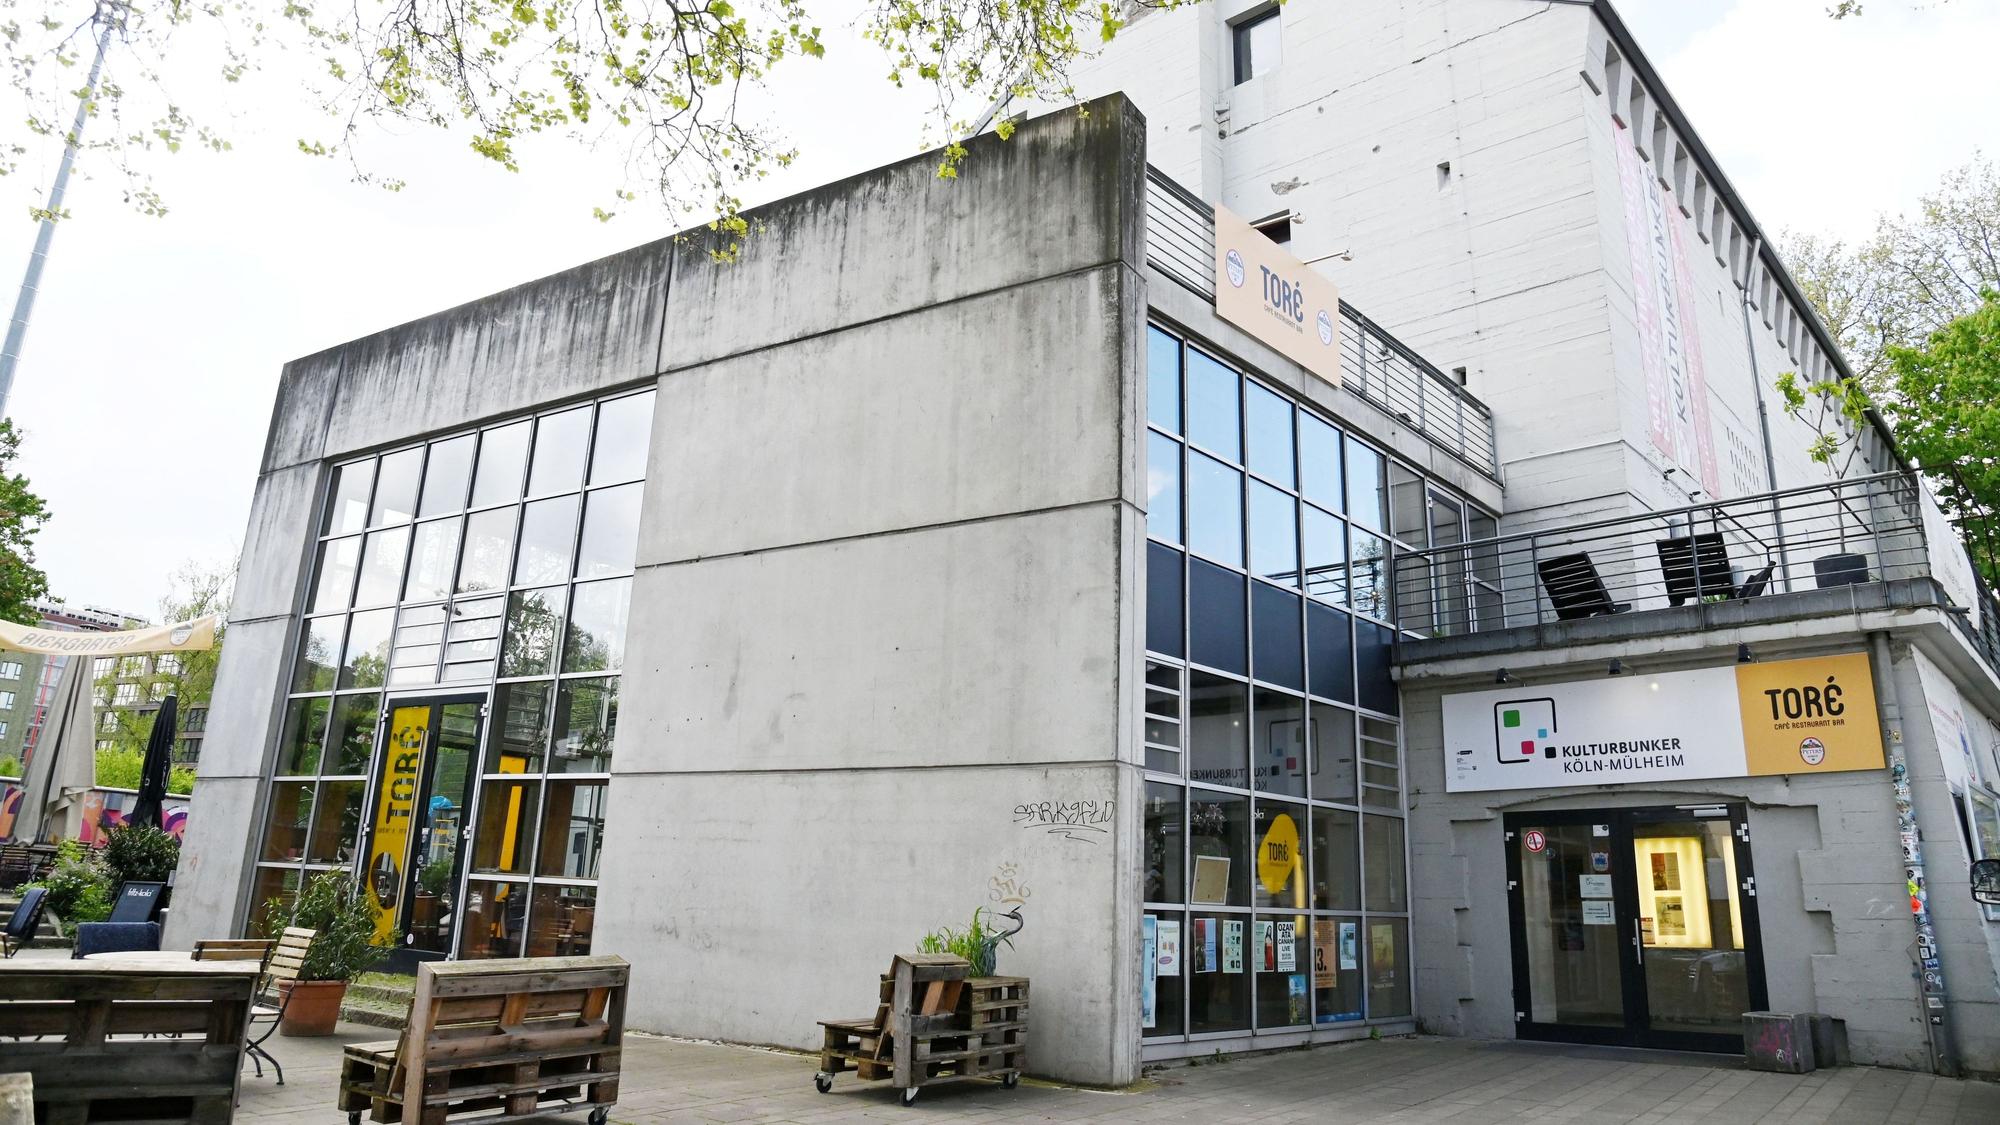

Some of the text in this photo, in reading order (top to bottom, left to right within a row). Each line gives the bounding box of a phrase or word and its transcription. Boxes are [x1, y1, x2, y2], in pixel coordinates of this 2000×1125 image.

[1260, 264, 1303, 323] TORÉ
[1646, 167, 1688, 422] KULTURBUNKER
[1764, 675, 1845, 720] TORÉ
[1774, 718, 1845, 731] CAFÉ RESTAURANT BAR
[1562, 737, 1682, 758] KULTURBUNKER
[1563, 754, 1685, 774] KÖLN-MÜLHEIM
[1278, 923, 1294, 932] OZAN
